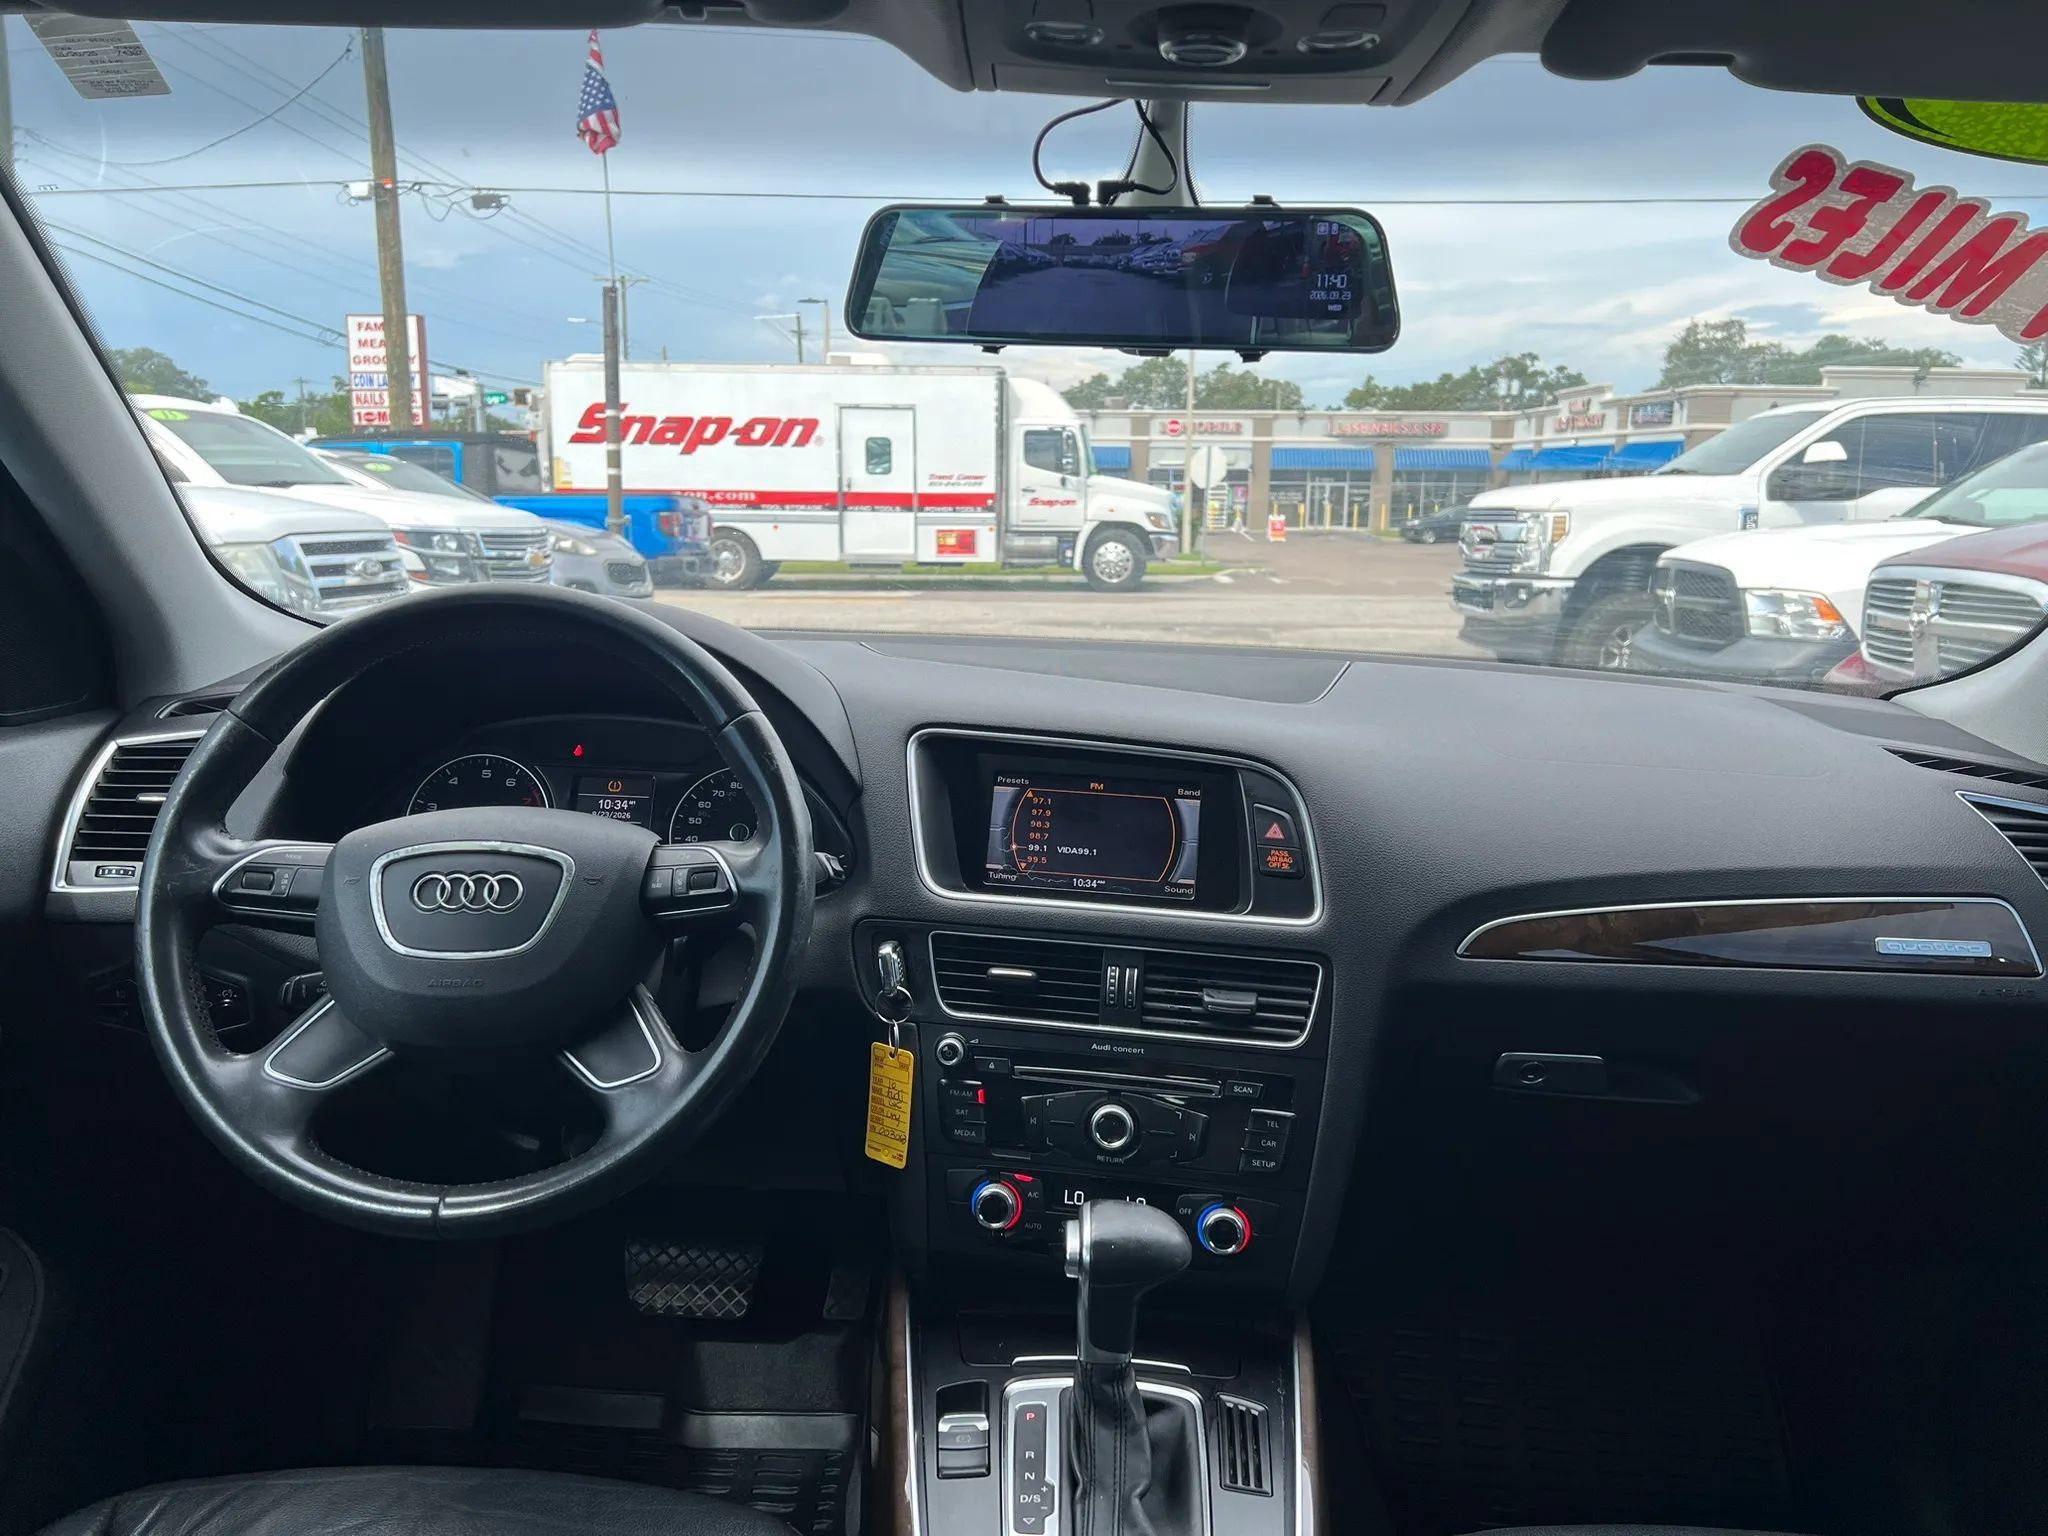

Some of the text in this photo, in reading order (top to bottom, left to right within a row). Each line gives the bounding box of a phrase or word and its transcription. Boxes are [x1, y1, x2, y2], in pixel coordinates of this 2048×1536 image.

[1318, 274, 1347, 288] 11:40
[354, 373, 374, 386] COIN
[355, 394, 385, 404] NAILS
[568, 402, 819, 455] Snap-on
[1028, 497, 1077, 507] Snap-on
[482, 769, 492, 778] 5
[448, 777, 458, 785] 4
[506, 778, 516, 787] 6
[997, 776, 1029, 785] Presets
[1090, 782, 1104, 791] FM
[1178, 788, 1200, 797] Band
[598, 799, 628, 810] 10:34
[1032, 797, 1051, 805] 97.1
[427, 803, 437, 811] 3
[1031, 809, 1051, 817] 97.9
[1030, 820, 1050, 829] 98.3
[1029, 832, 1048, 840] 98.7
[1028, 844, 1097, 856] 99.1 VIDA99.1
[1027, 855, 1047, 864] 99.5
[988, 871, 1017, 881] Tuning
[1073, 878, 1097, 888] 10:34
[1164, 885, 1193, 895] Sound
[1886, 942, 1984, 953] quattro
[428, 979, 483, 988] AIRBAG
[1091, 1043, 1145, 1055] Audi concert
[950, 1089, 973, 1097] FM/AM
[1233, 1085, 1253, 1094] SCAN
[1267, 1120, 1279, 1128] TEL
[954, 1129, 976, 1137] MEDIA
[1261, 1139, 1277, 1147] CAR
[1096, 1154, 1125, 1164] RETURN
[1252, 1159, 1276, 1168] SETUP
[1028, 1191, 1040, 1199] A/C
[1064, 1189, 1084, 1205] LO
[1025, 1222, 1042, 1230] AUTO
[1026, 1413, 1035, 1421] P
[1025, 1451, 1035, 1459] R
[1024, 1472, 1035, 1480] N
[1020, 1494, 1041, 1503] D/S
